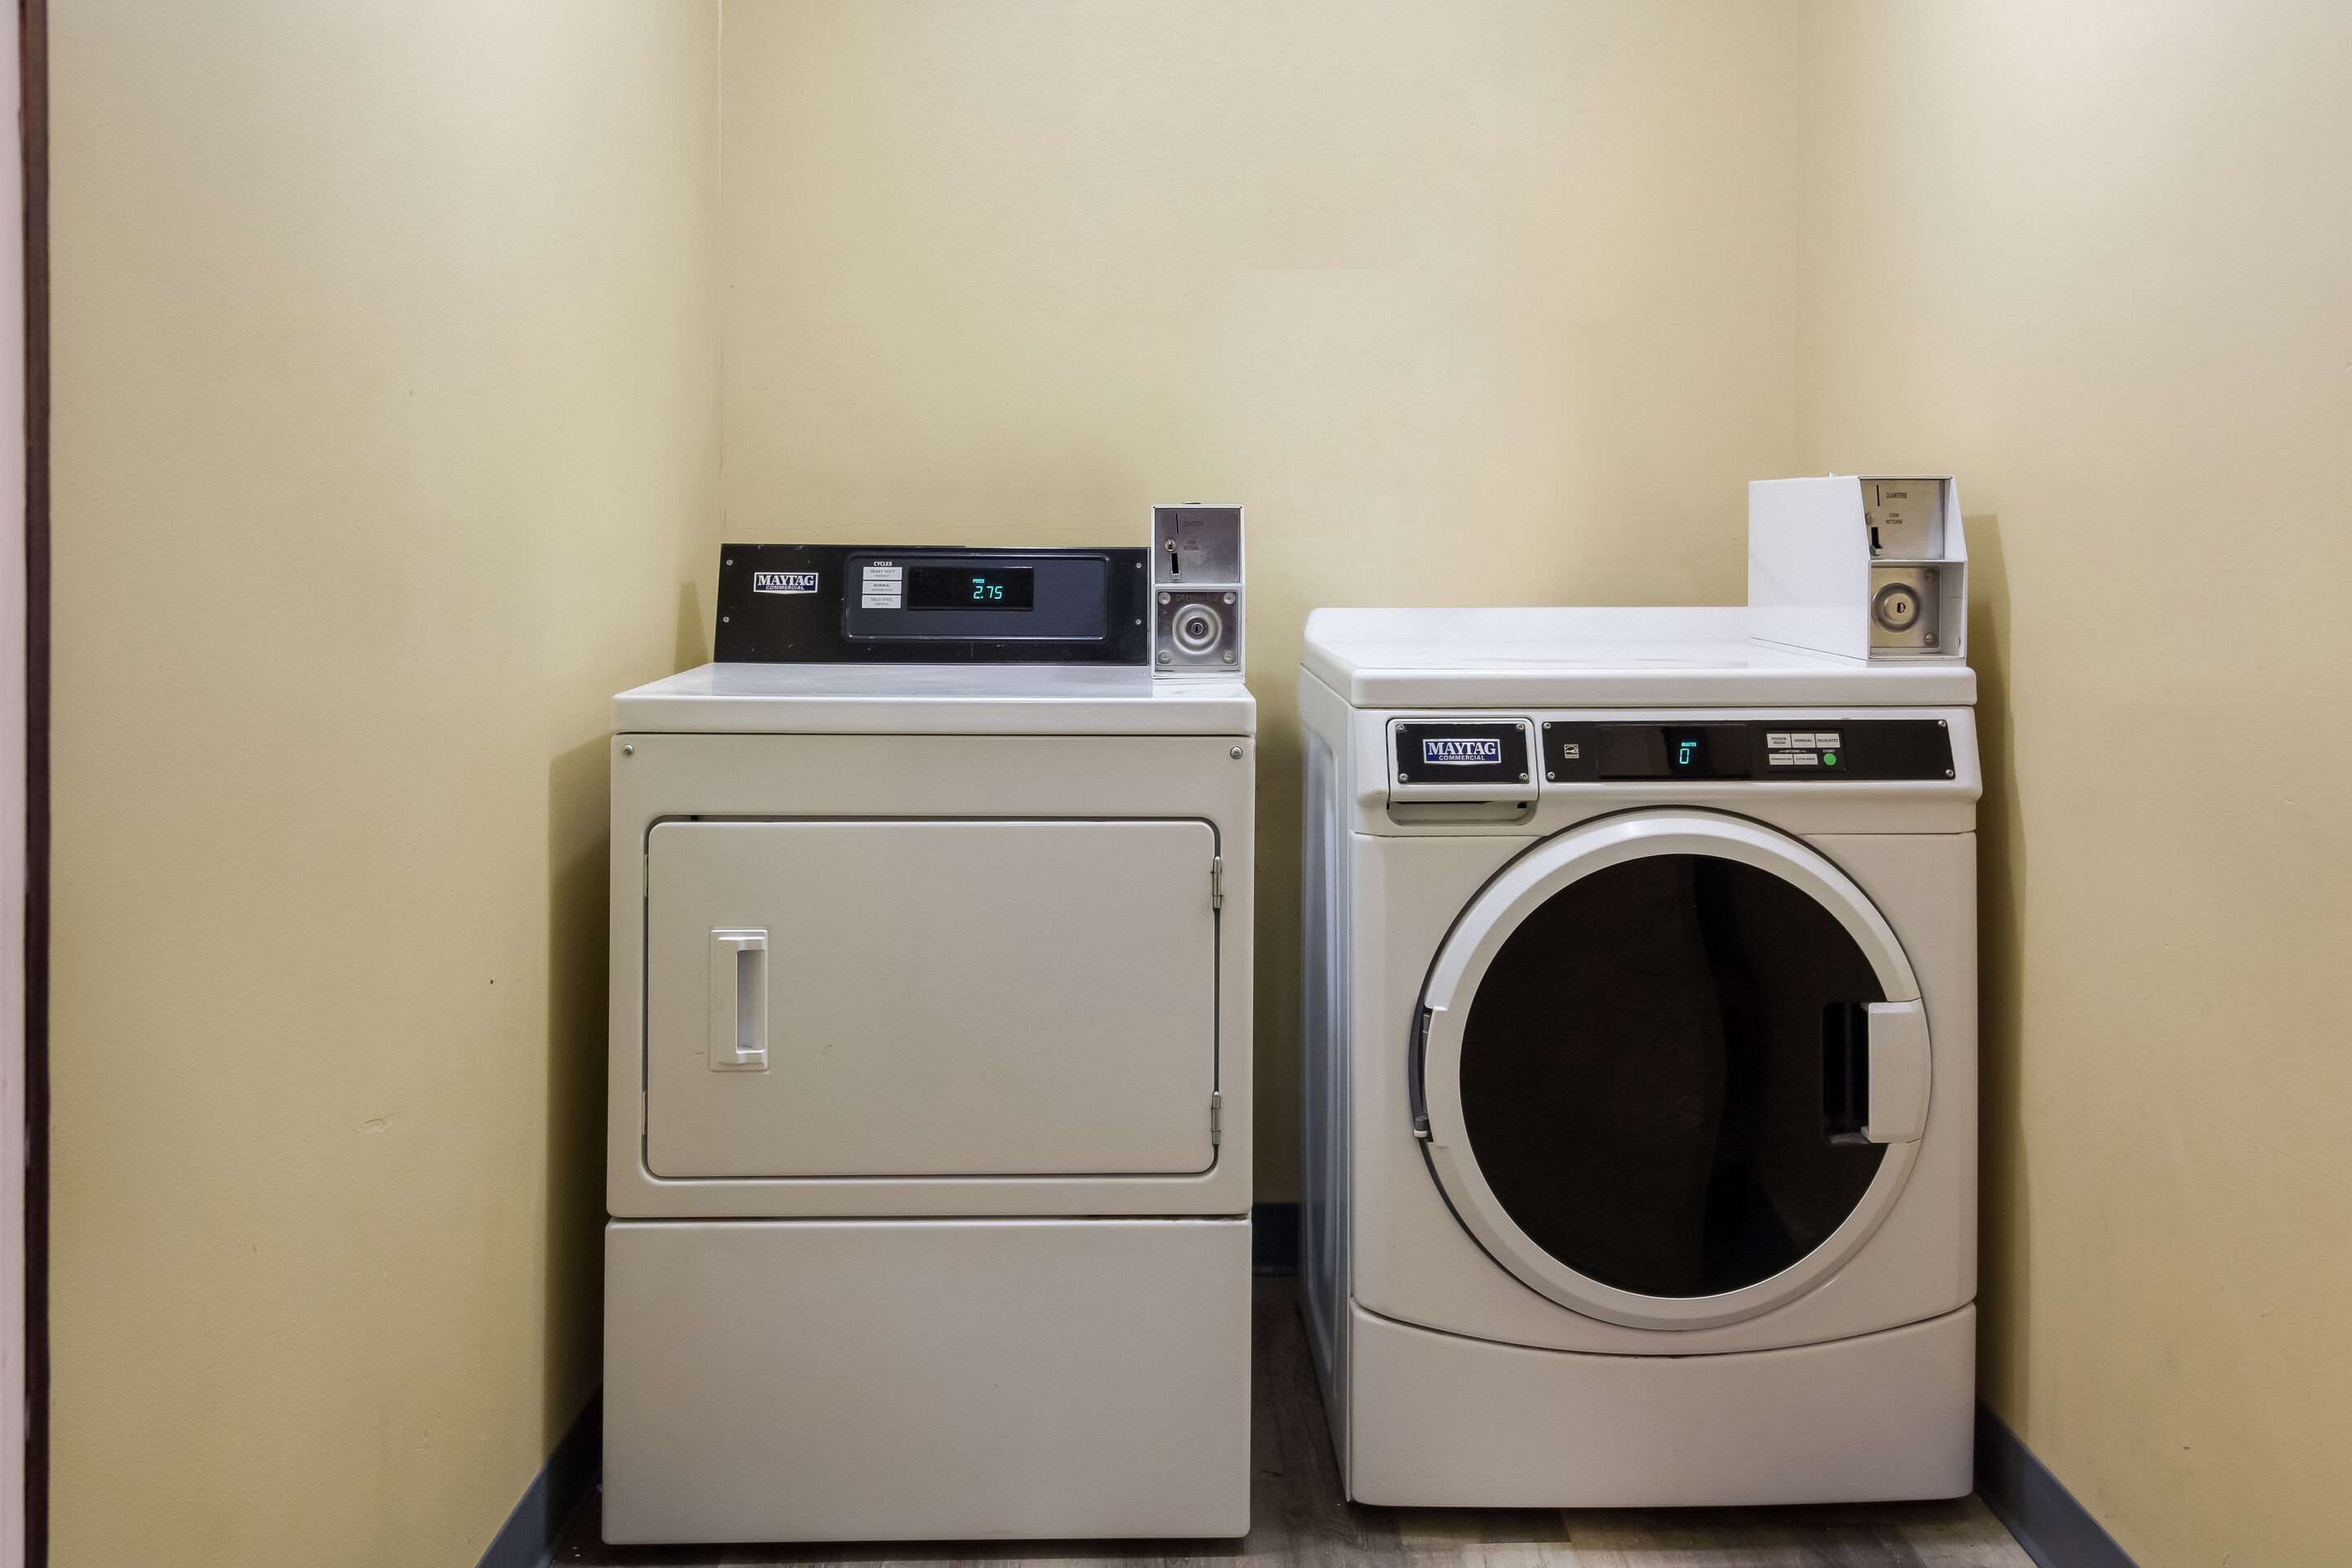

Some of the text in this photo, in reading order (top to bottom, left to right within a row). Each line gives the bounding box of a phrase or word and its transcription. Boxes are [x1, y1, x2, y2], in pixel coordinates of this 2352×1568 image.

[757, 574, 815, 586] MAYTAG
[973, 586, 1004, 599] 2.75
[1175, 594, 1219, 602] GREENWALD
[1427, 742, 1497, 755] MAYTAG
[1679, 748, 1690, 764] 0
